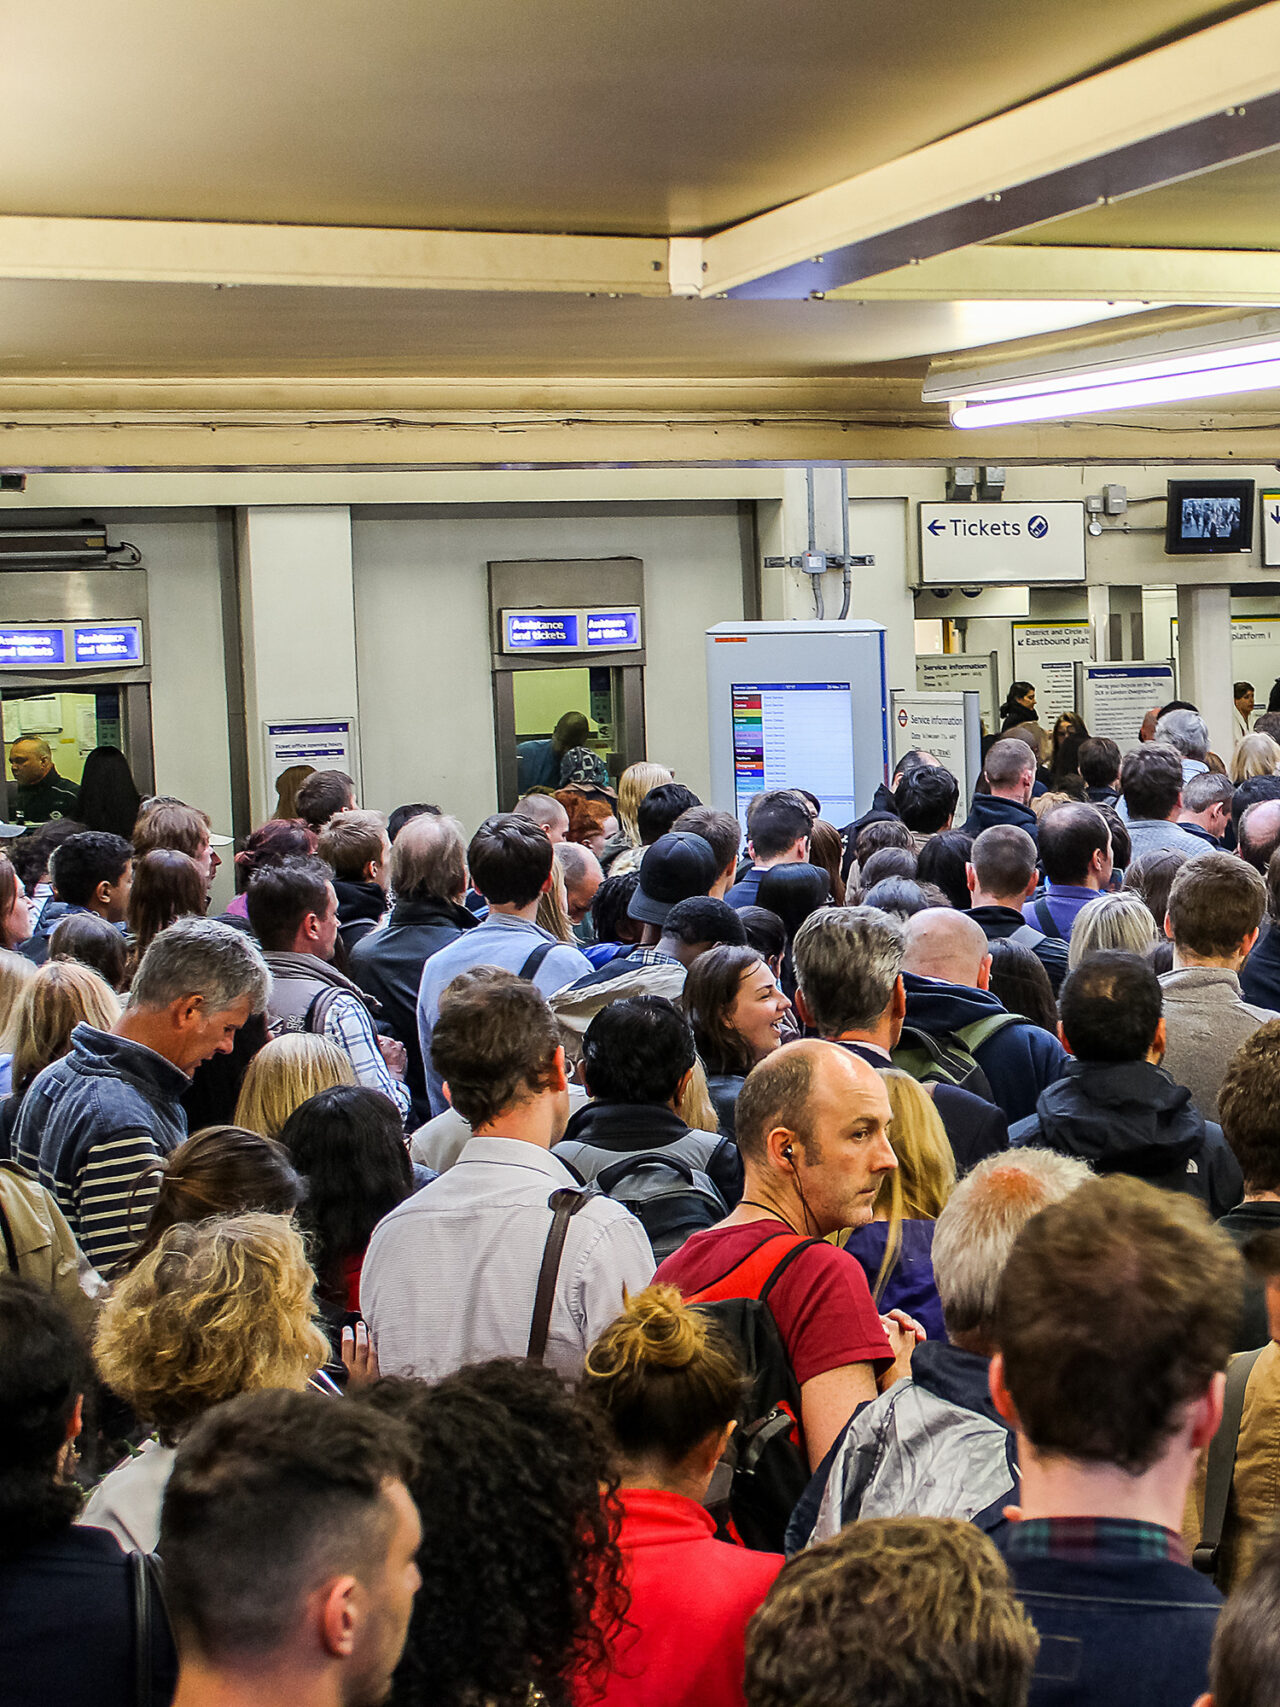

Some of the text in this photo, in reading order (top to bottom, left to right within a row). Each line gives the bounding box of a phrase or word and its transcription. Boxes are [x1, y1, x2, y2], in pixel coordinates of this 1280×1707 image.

[950, 519, 1021, 536] Tickets
[512, 620, 564, 630] Assistance
[512, 630, 567, 640] and tickets
[1231, 632, 1266, 641] platform
[1026, 638, 1070, 646] Eastbound
[911, 714, 963, 726] Service information
